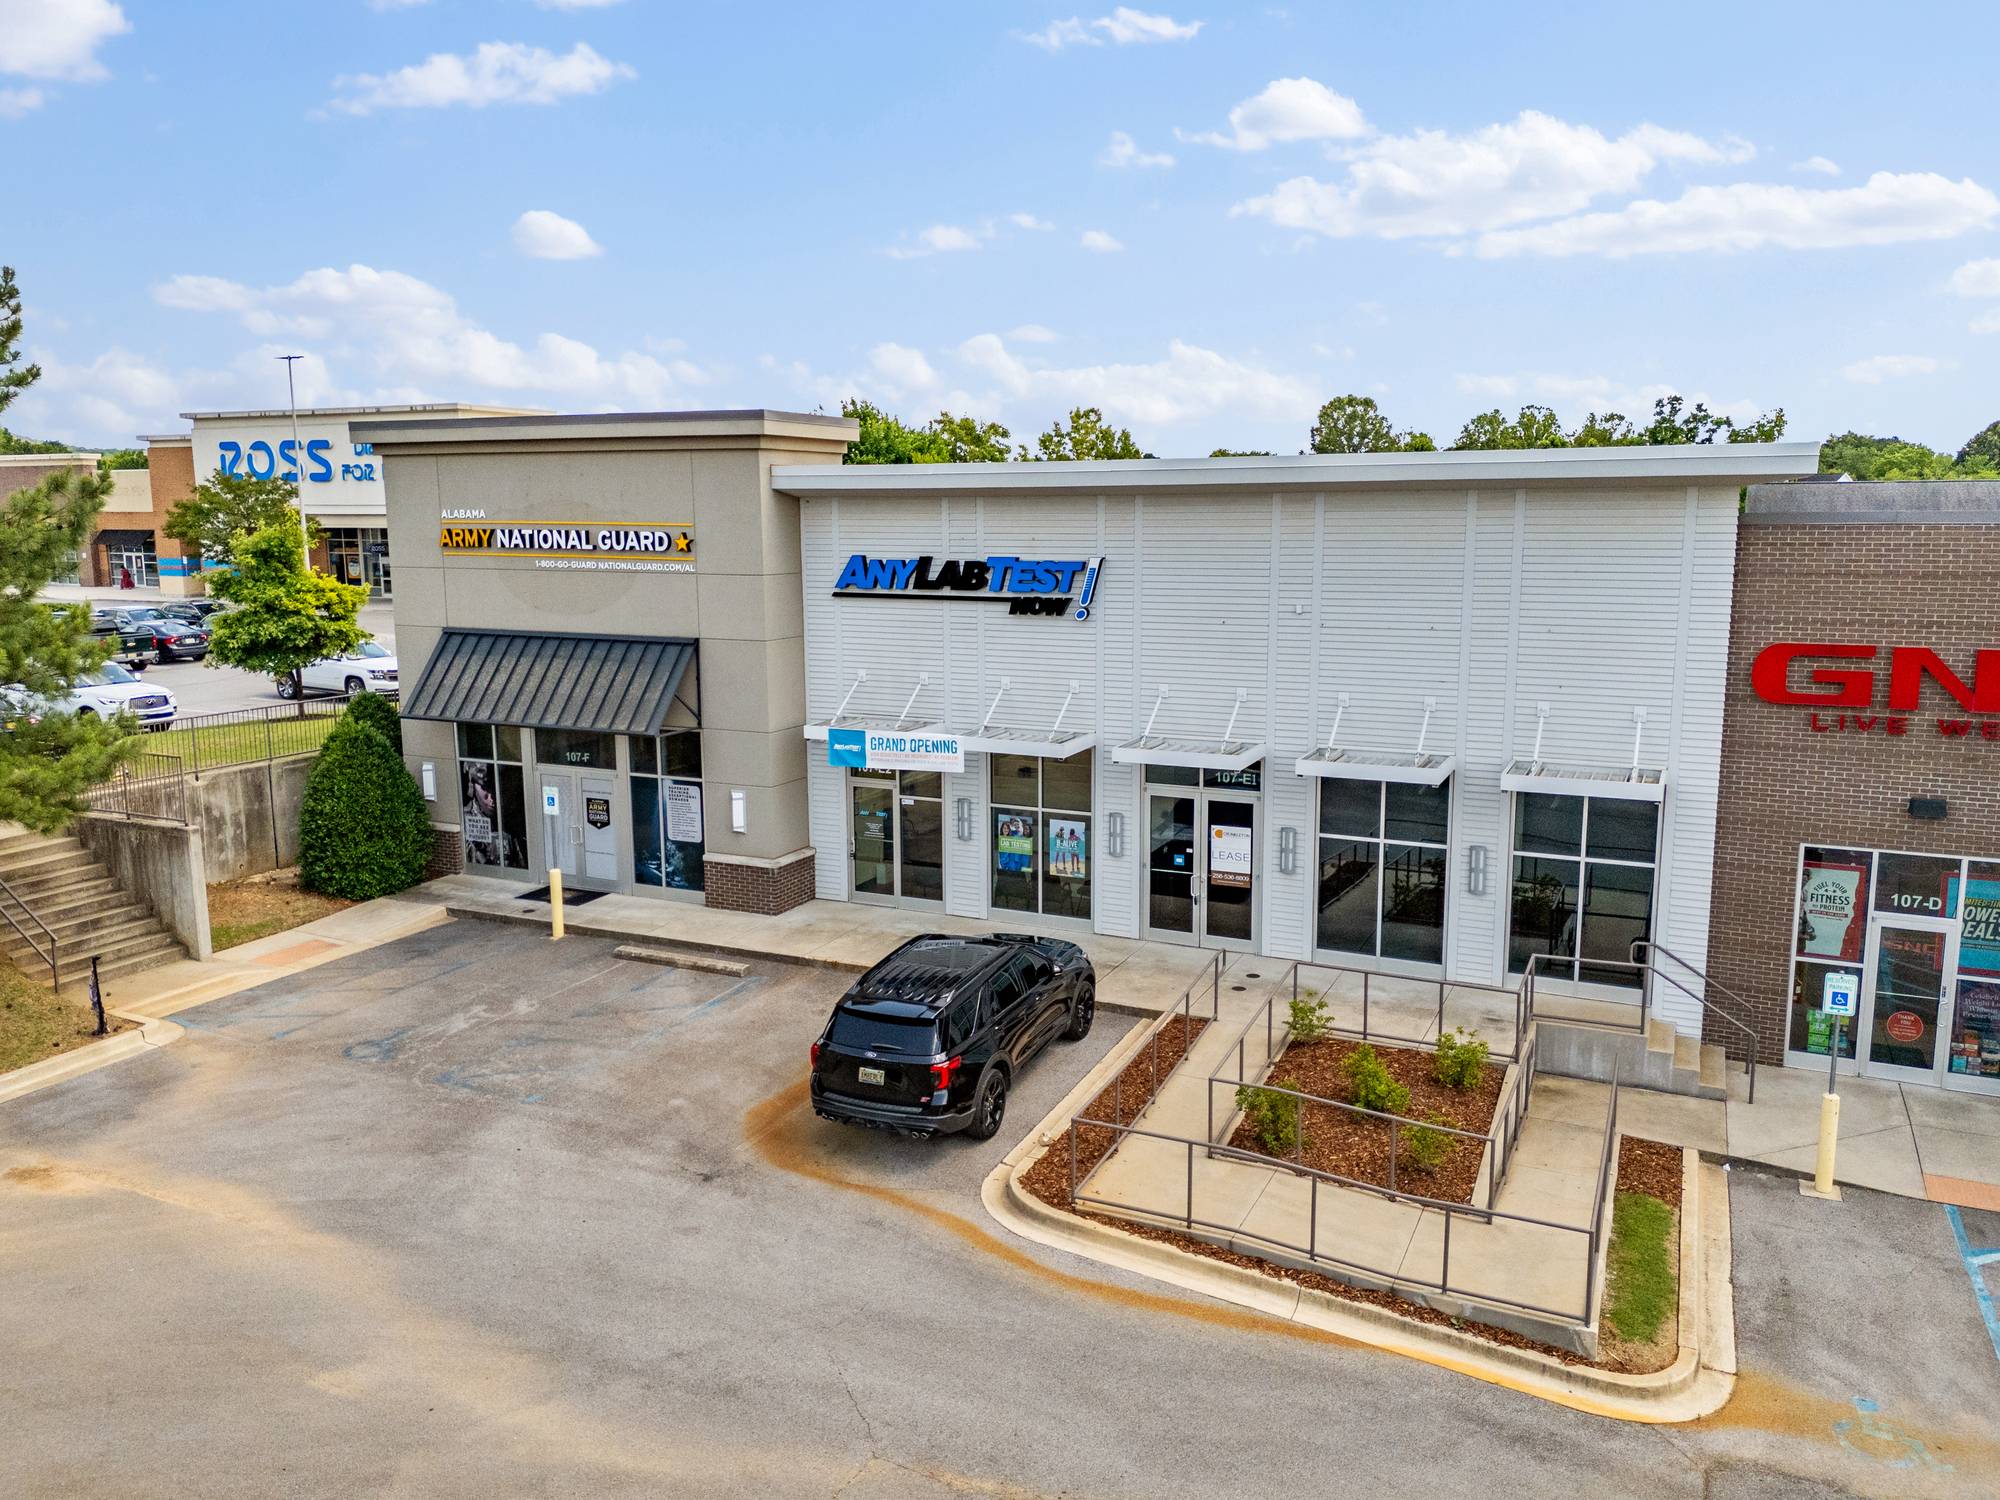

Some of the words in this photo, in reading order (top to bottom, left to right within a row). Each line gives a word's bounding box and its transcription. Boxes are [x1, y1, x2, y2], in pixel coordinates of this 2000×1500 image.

[218, 439, 334, 483] ROSS
[341, 463, 376, 481] FOR
[441, 509, 486, 519] ALABAMA
[440, 528, 495, 548] ARMY
[496, 529, 597, 550] NATIONAL
[597, 531, 672, 552] GUARD
[535, 560, 597, 570] 1-800-GO-GUARD
[598, 562, 695, 573] NATIONALGUARD.COM/AL
[1009, 596, 1072, 616] NOW
[1811, 713, 1908, 735] LIVE
[870, 737, 906, 752] GRAND
[909, 739, 958, 754] OPENING
[566, 752, 590, 762] 107-F
[588, 803, 608, 811] ARMY
[588, 813, 608, 821] GUARD
[1211, 850, 1250, 862] LEASE
[1813, 881, 1829, 893] FUEL
[1831, 881, 1848, 895] YOUR
[1810, 893, 1850, 906] FITNESS
[1891, 893, 1942, 910] 107-D
[1820, 904, 1845, 912] PROTEIN
[1963, 906, 2000, 923] OWE
[1961, 921, 2000, 941] EAL
[1897, 1013, 1915, 1021] THANK
